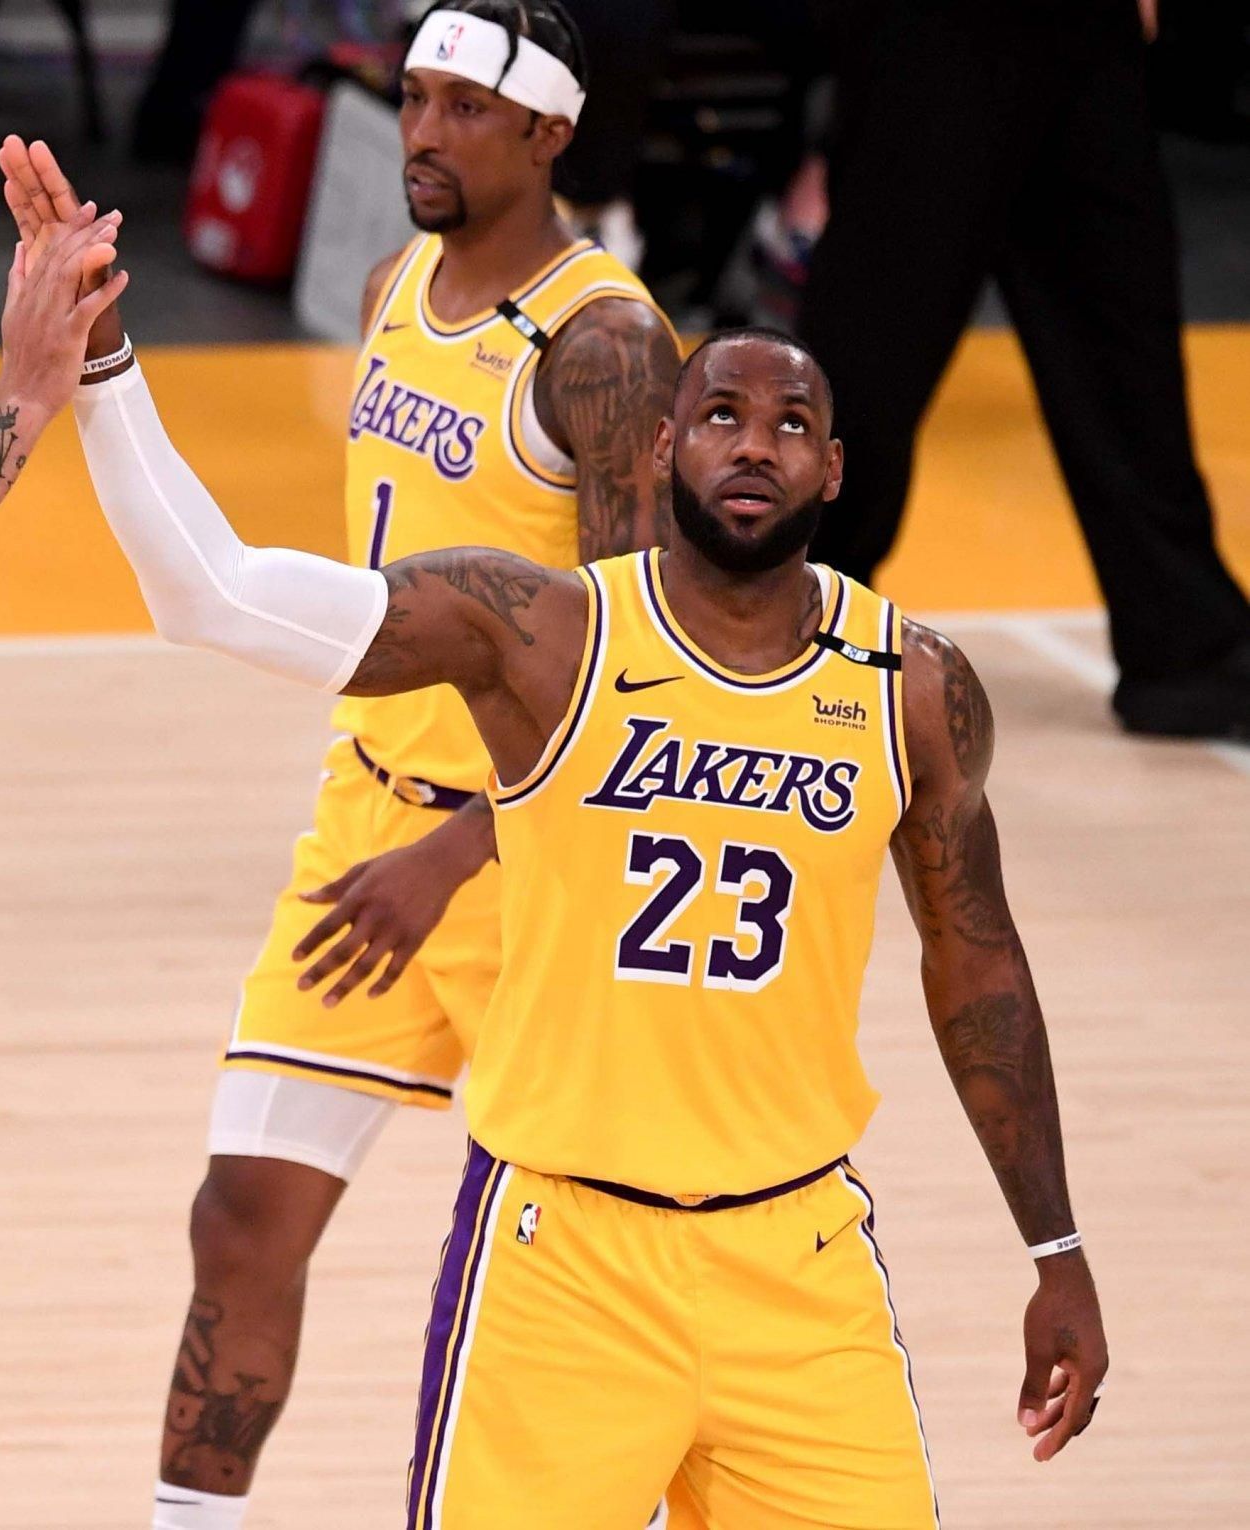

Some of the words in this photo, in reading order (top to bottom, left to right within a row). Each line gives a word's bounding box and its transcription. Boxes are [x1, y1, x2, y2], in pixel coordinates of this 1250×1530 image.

[83, 364, 89, 372] I
[350, 357, 485, 481] LAKERS
[368, 480, 393, 570] 1
[812, 694, 867, 722] wish
[813, 716, 867, 731] SHOPPING
[581, 716, 862, 834] LAKERS
[614, 830, 797, 993] 23
